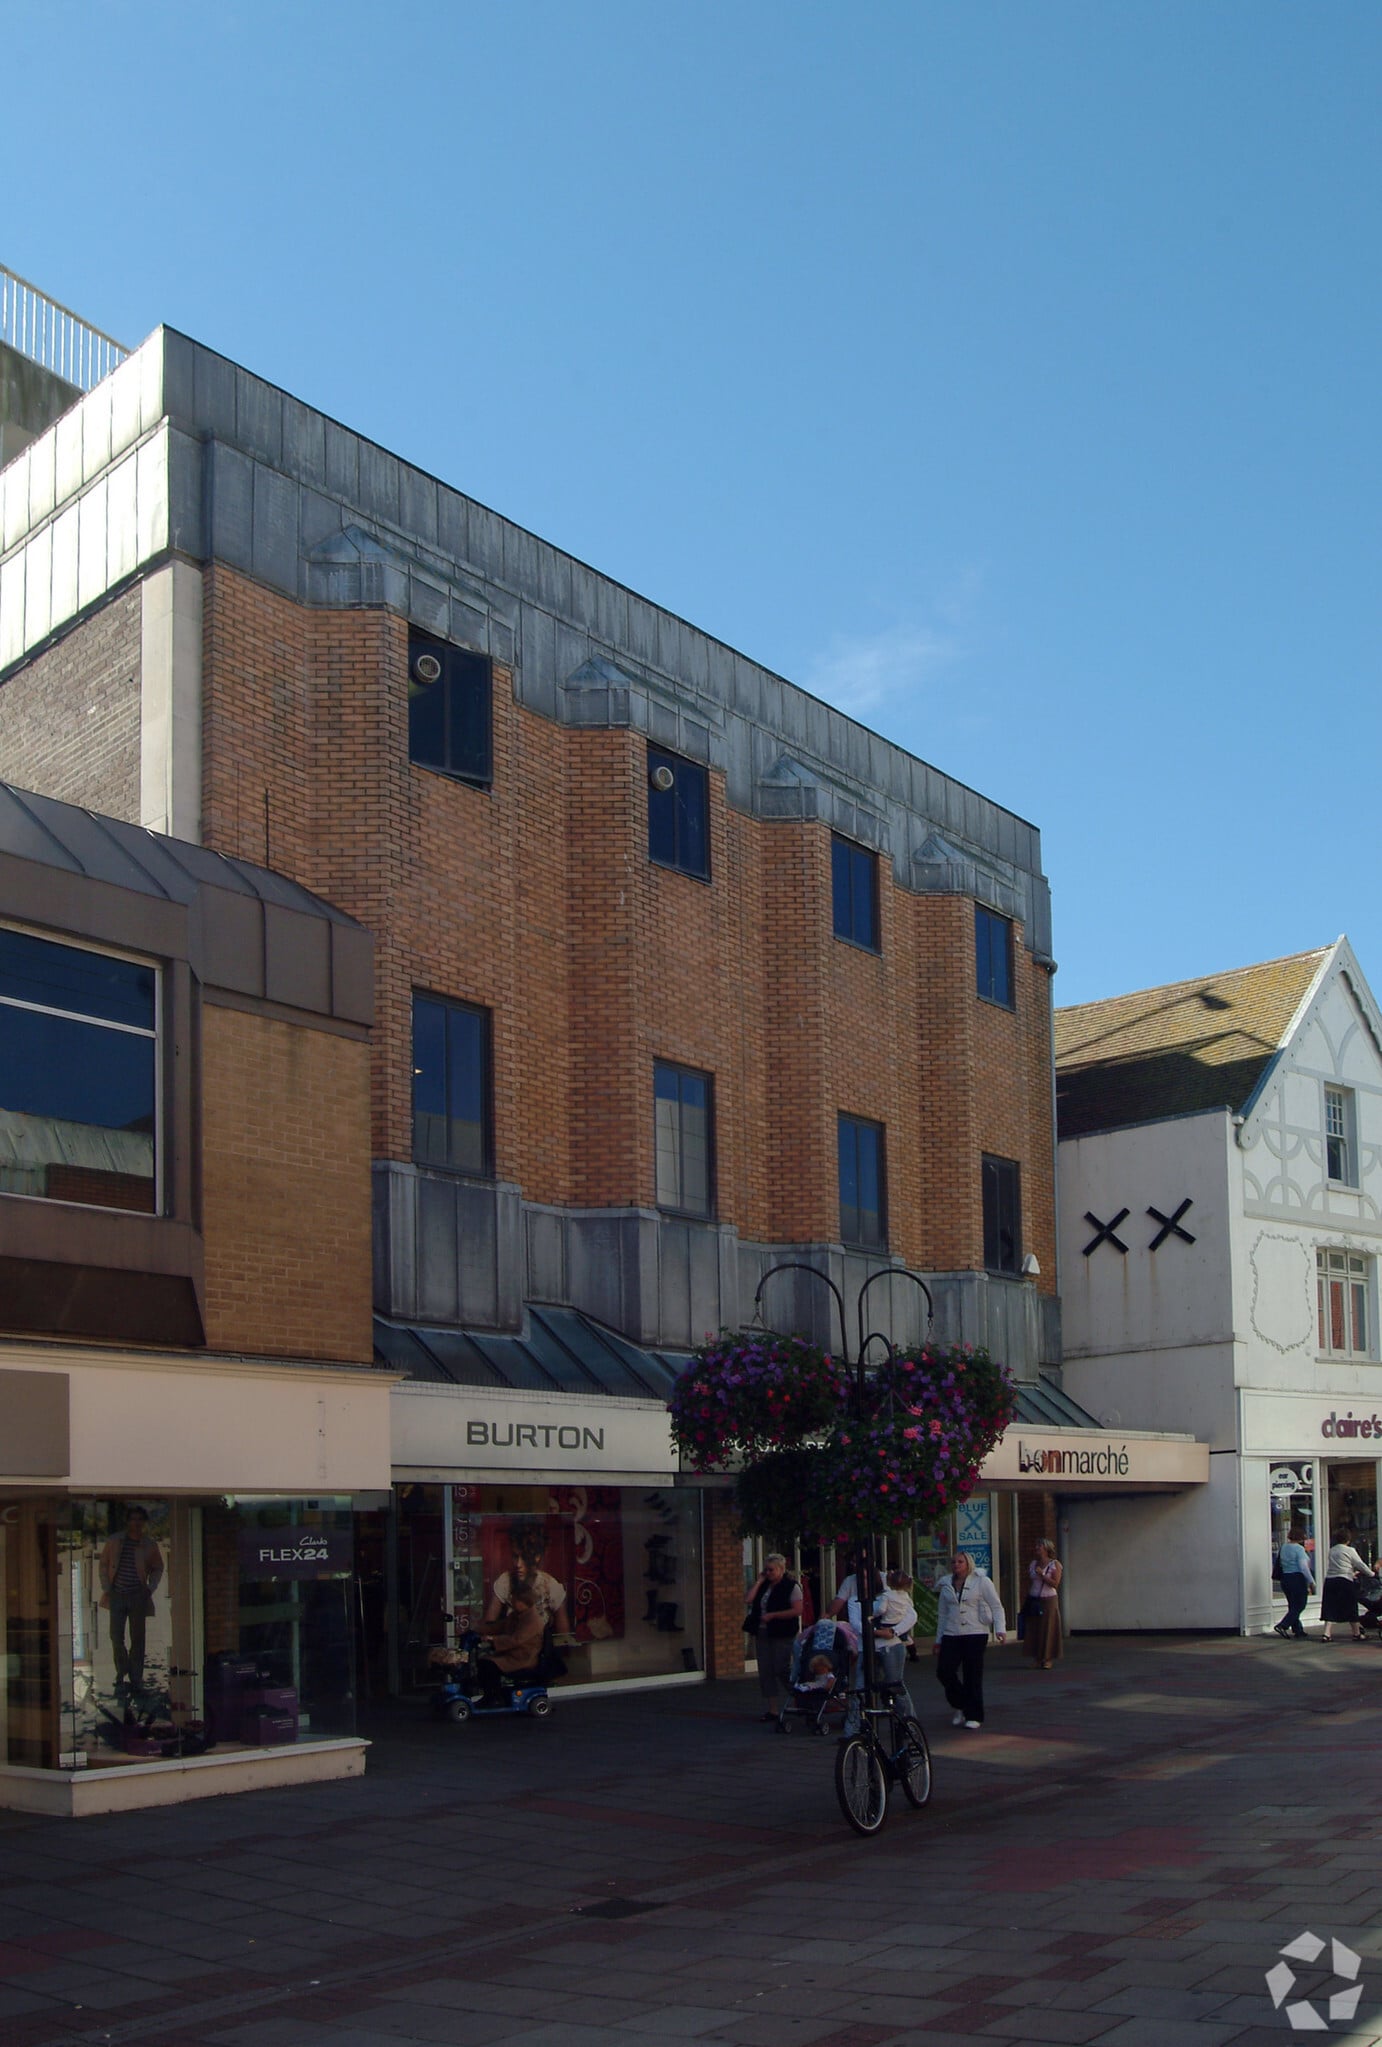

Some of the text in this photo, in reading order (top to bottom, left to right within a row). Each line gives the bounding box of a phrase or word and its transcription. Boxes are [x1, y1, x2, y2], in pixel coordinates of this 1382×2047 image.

[1321, 1411, 1382, 1439] claire's
[466, 1421, 604, 1450] BURTON
[1019, 1440, 1129, 1475] bonmarché
[1272, 1481, 1295, 1490] piercing
[959, 1504, 988, 1513] BLUE
[959, 1531, 987, 1540] SALE
[259, 1548, 329, 1562] FLEX24
